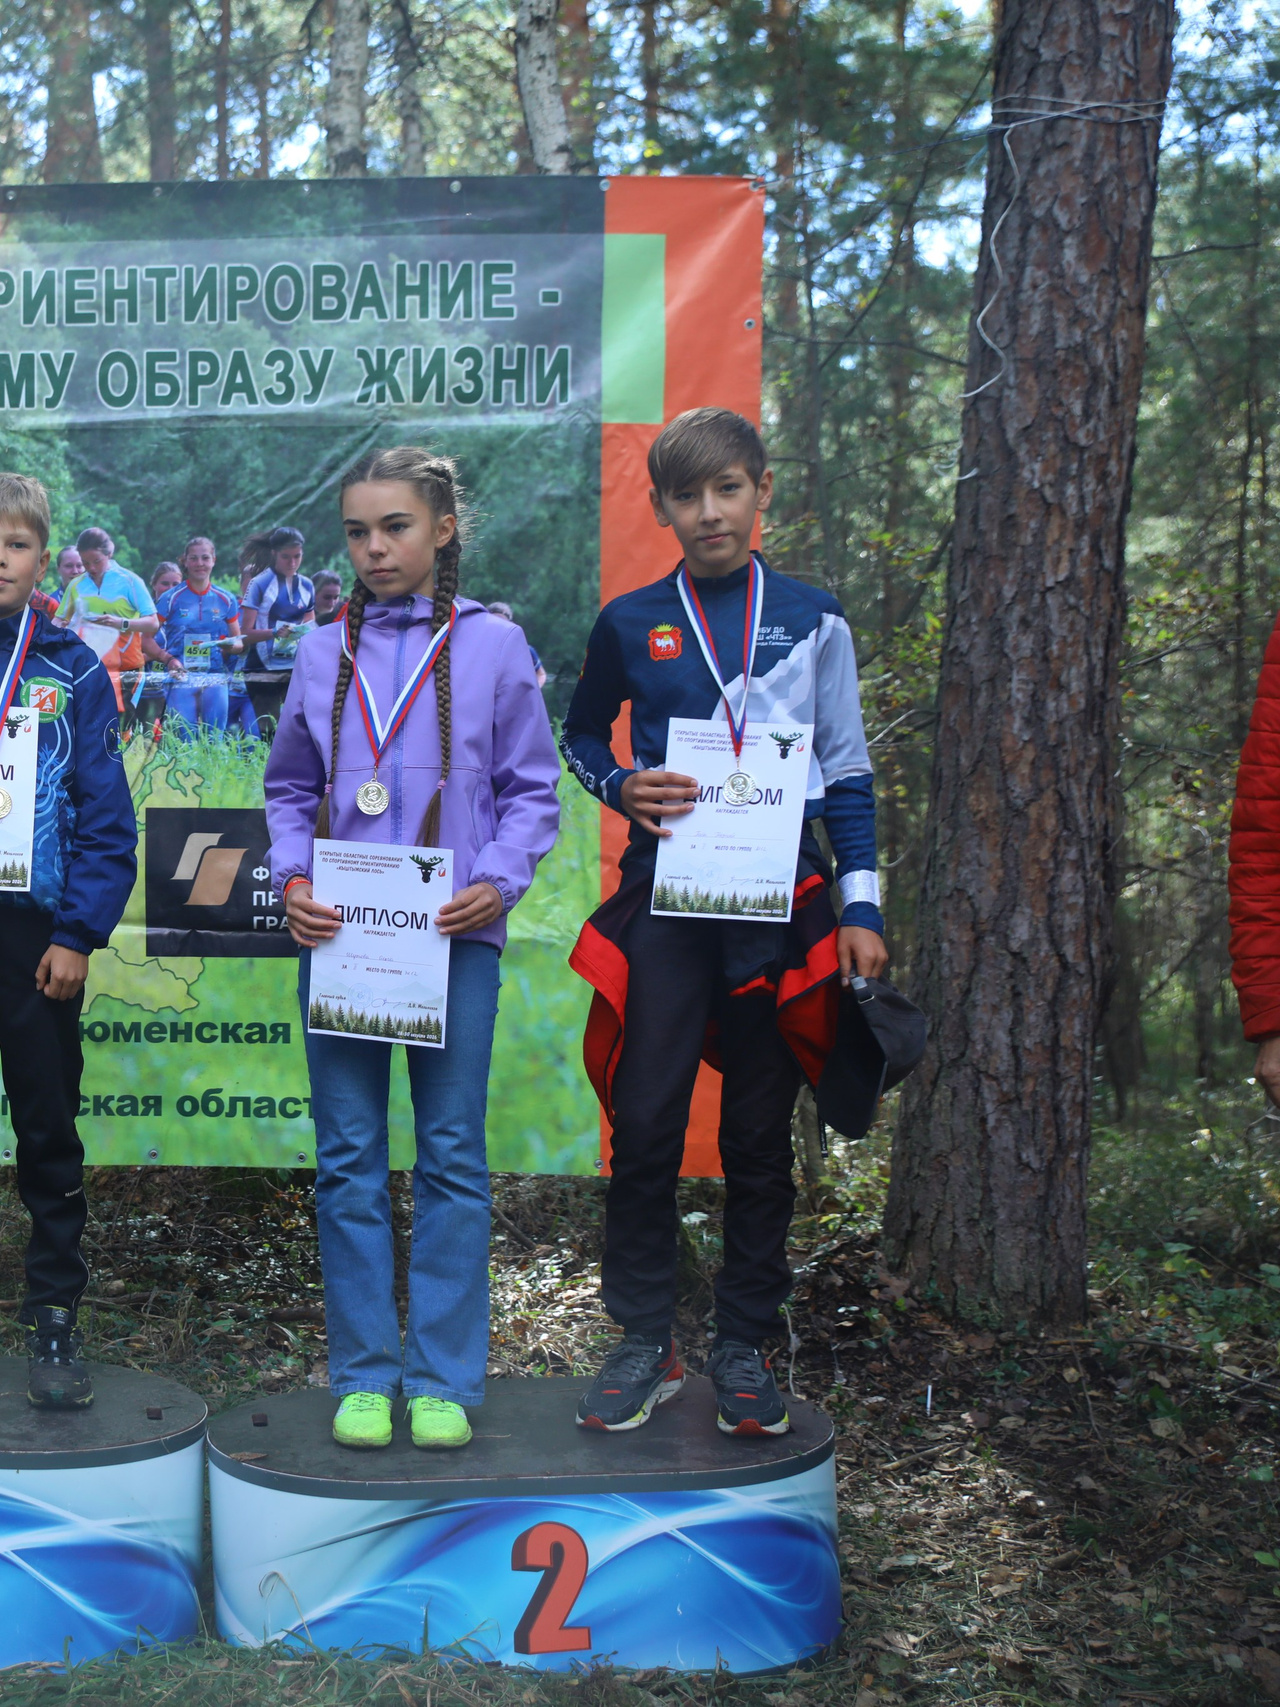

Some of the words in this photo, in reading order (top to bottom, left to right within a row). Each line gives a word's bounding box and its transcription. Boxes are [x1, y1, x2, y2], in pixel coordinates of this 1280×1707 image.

[96, 348, 335, 410] ОБРАЗУ
[356, 345, 572, 406] ЖИЗНИ
[329, 858, 359, 866] СПОРТИВНОМУ
[360, 861, 400, 869] ОРИЕНТИРОВАНИЮ
[332, 904, 428, 931] ДИПЛОМ
[363, 929, 396, 937] НАГРАЖДАЕТСЯ
[511, 1521, 592, 1655] 2
